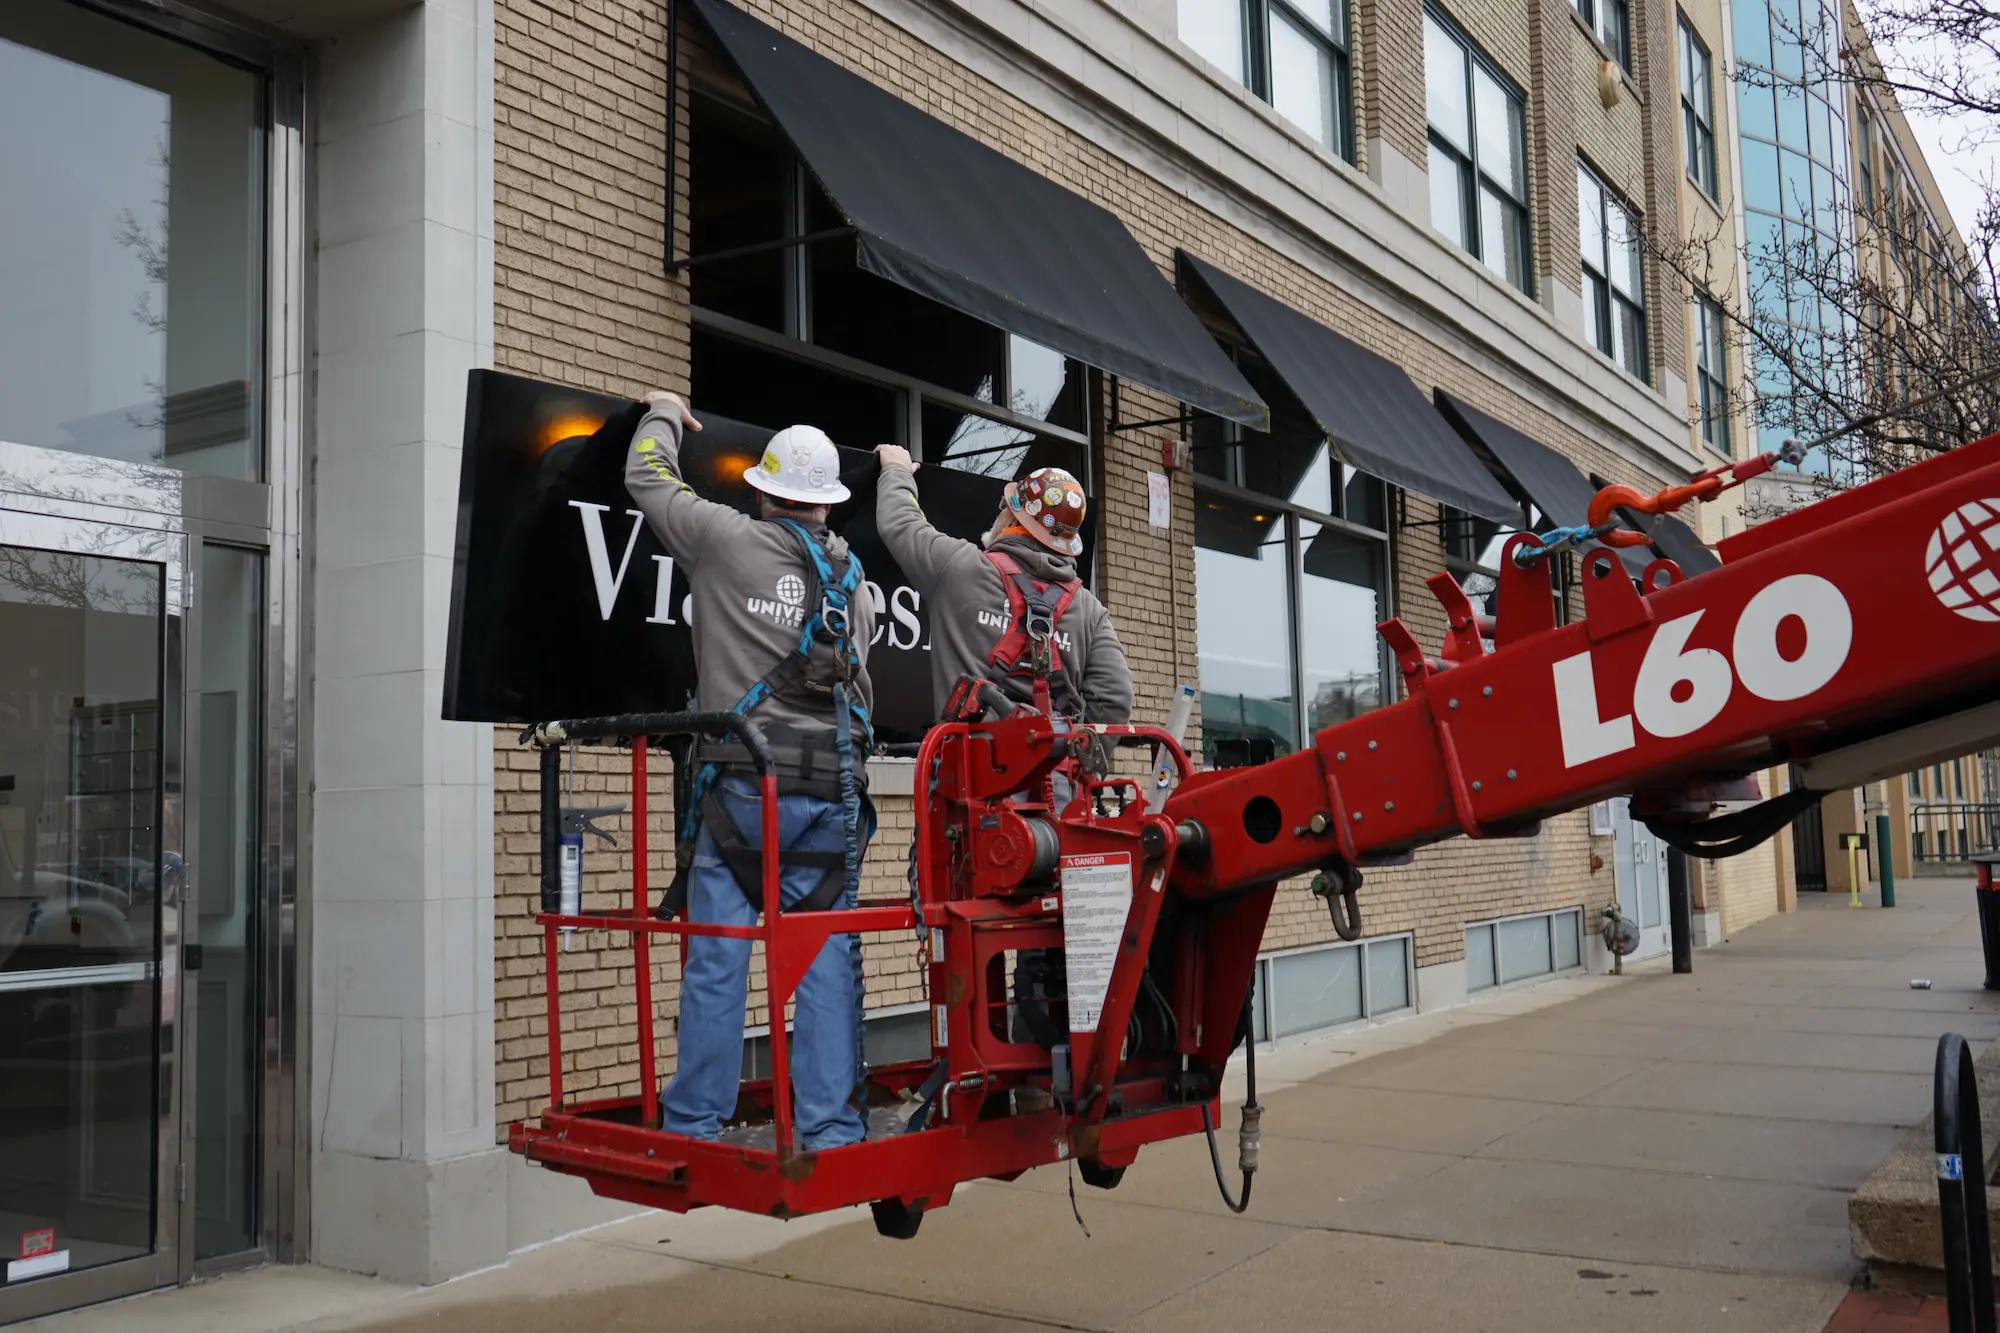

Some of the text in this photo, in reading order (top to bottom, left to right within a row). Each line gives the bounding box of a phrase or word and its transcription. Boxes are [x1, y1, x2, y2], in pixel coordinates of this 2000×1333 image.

[568, 499, 693, 628] Vi
[747, 597, 805, 621] UNIVE
[1552, 573, 1853, 769] L60
[1074, 856, 1105, 866] DANGER
